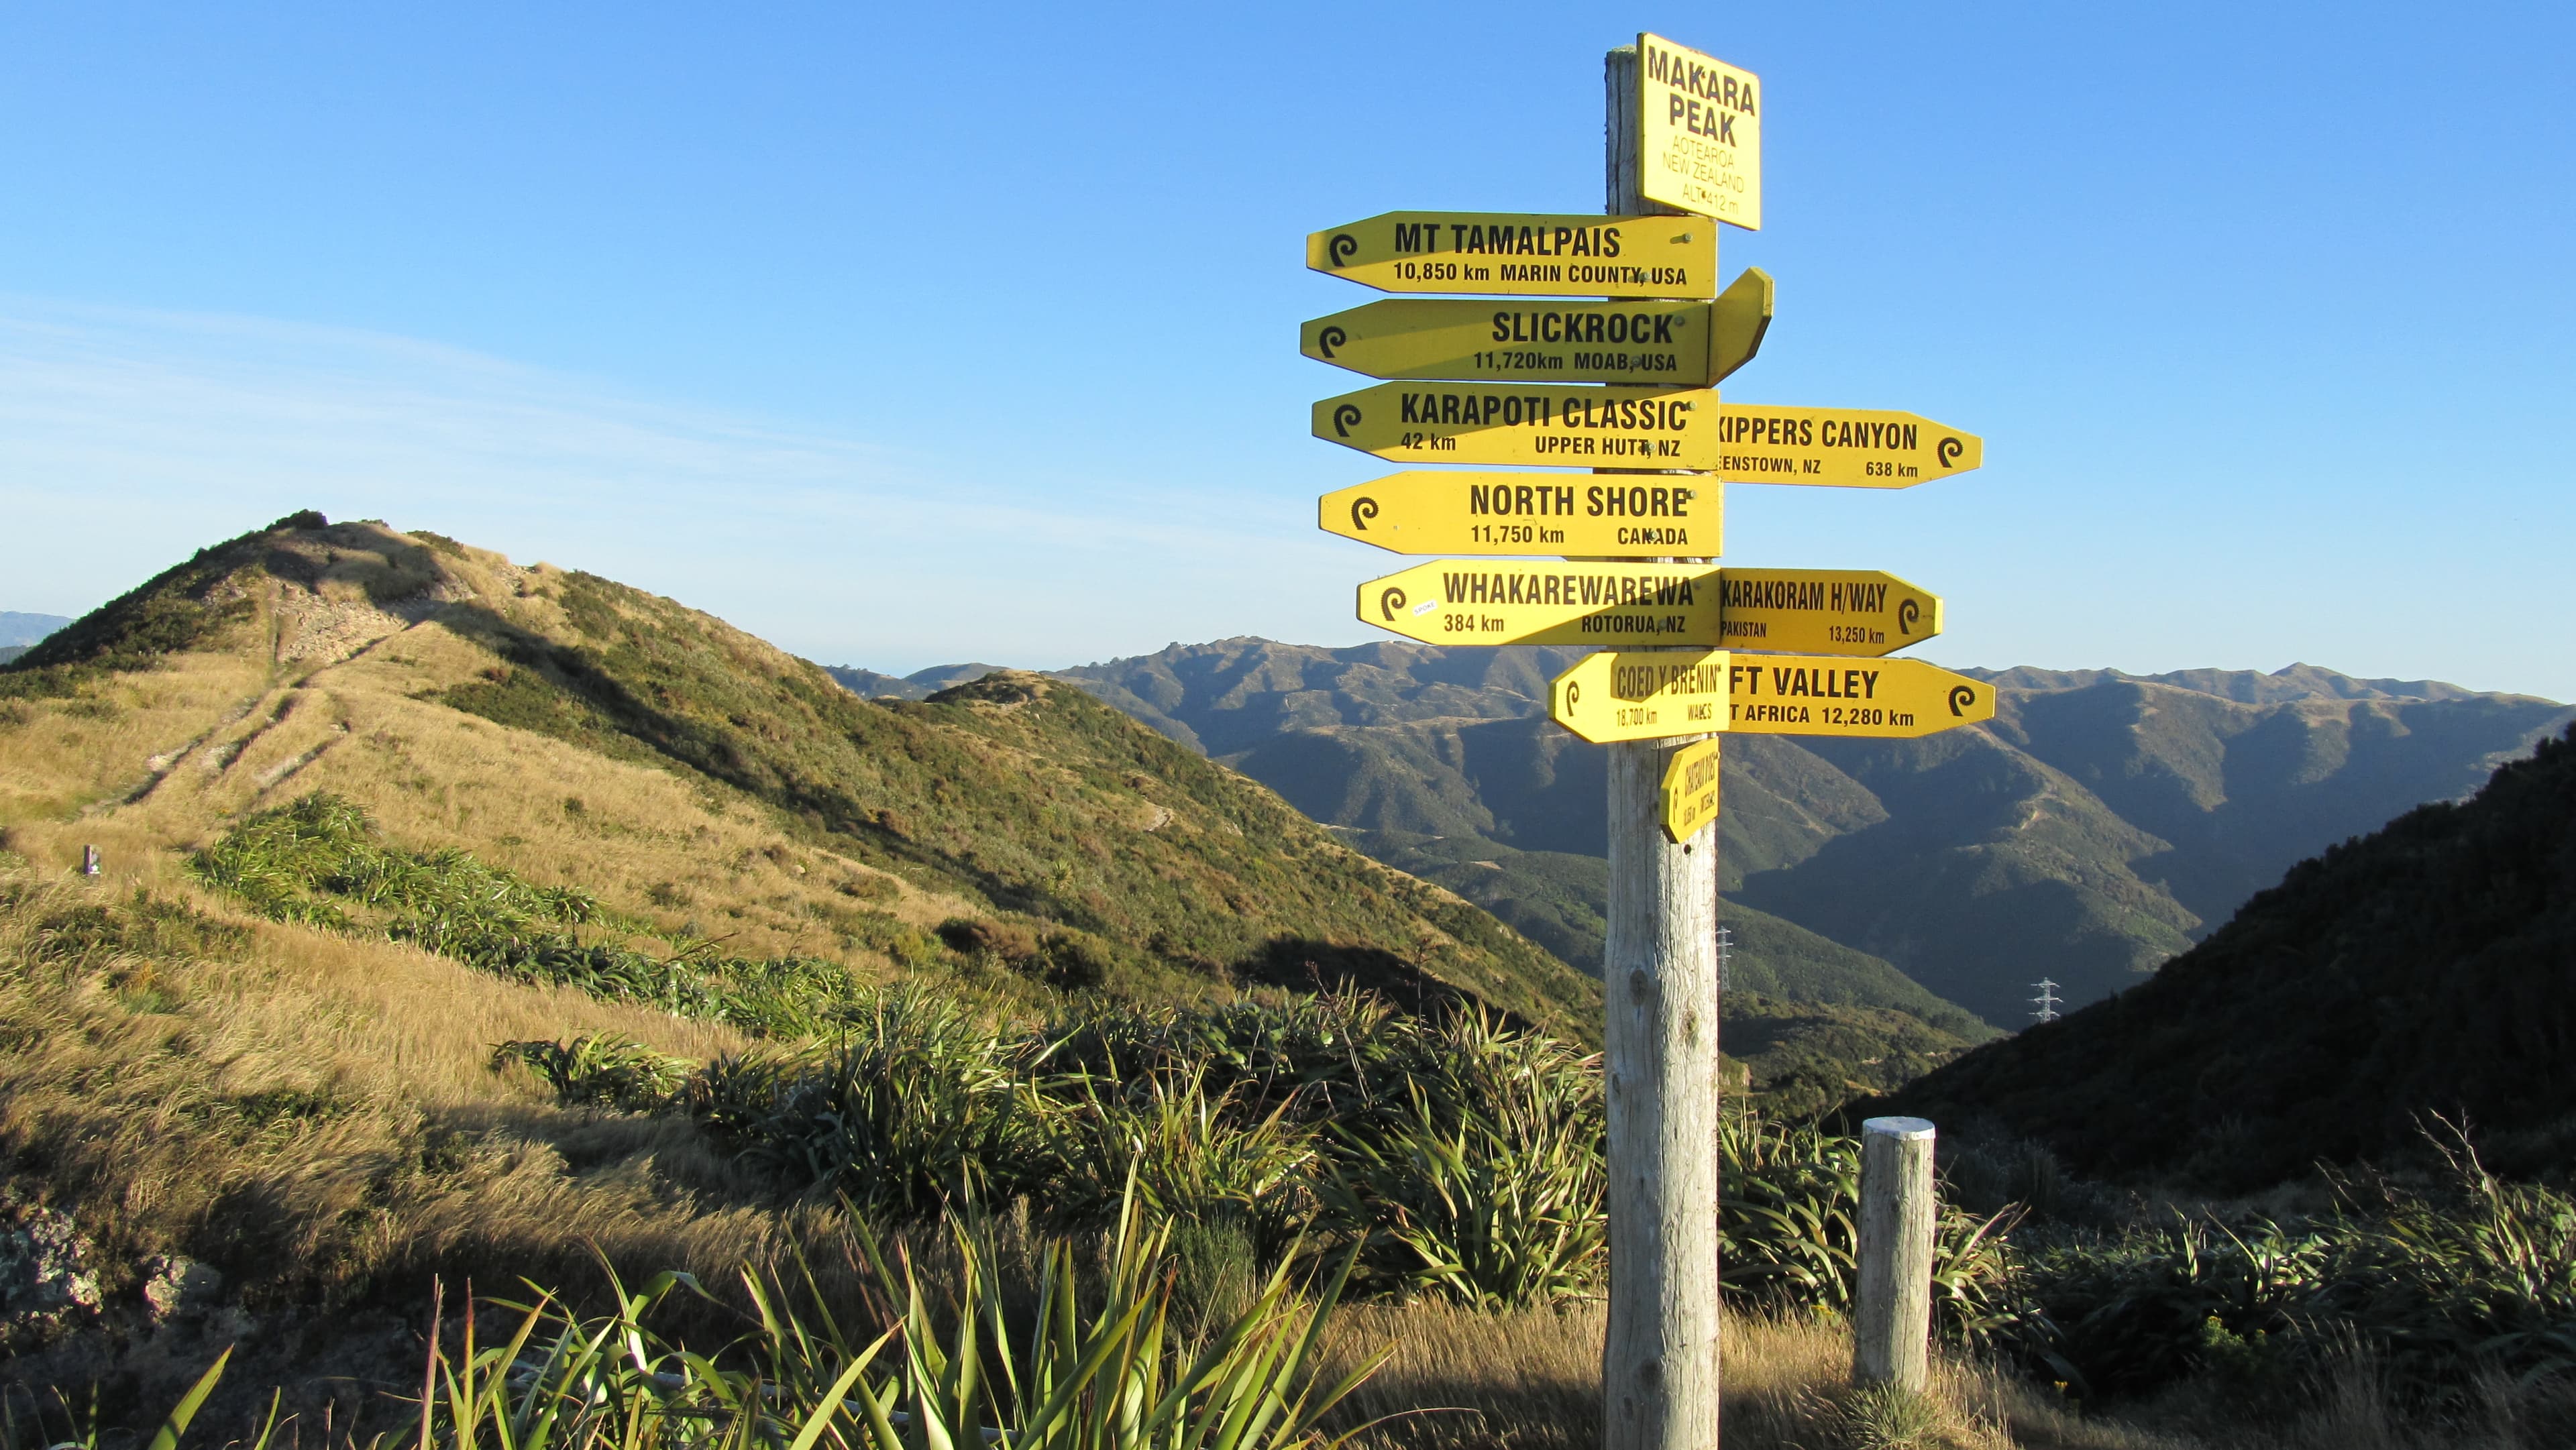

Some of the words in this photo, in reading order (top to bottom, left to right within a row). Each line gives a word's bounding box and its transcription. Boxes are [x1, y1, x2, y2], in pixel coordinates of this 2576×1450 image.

[1648, 45, 1756, 117] MAKARA
[1670, 93, 1737, 148] PEAK
[1672, 135, 1734, 169] AOTEAROA
[1663, 152, 1690, 176] NEW
[1693, 161, 1744, 193] ZEALAND
[1707, 192, 1725, 211] 412
[1729, 201, 1738, 215] m
[1395, 223, 1440, 252] MT
[1450, 224, 1621, 258] TAMALPAIS
[1394, 262, 1457, 283] 10,850
[1464, 263, 1489, 280] km
[1501, 264, 1562, 282] MARIN
[1568, 265, 1644, 287] COUNTY,
[1652, 267, 1687, 285] USA
[1493, 312, 1674, 344] SLICKROCK
[1474, 352, 1563, 372] 11,720km
[1574, 353, 1635, 374] MOAB,
[1642, 355, 1677, 372] USA
[1401, 393, 1550, 427] KARAPOTI
[1562, 398, 1687, 431] CLASSIC
[1401, 433, 1423, 450] 42
[1431, 433, 1456, 451] km
[1535, 435, 1595, 455] UPPER
[1602, 437, 1651, 459] HUTT,
[1659, 439, 1680, 457] NZ
[1821, 420, 1917, 450] CANYON
[1719, 455, 1798, 476] ENSTOWN,
[1803, 459, 1821, 474] NZ
[1866, 461, 1892, 477] 638
[1898, 462, 1919, 478] km
[1470, 485, 1574, 516] NORTH
[1587, 486, 1688, 517] SHORE
[1471, 525, 1532, 546] 11,750
[1540, 526, 1564, 543] km
[1617, 526, 1688, 545] CANADA
[1444, 572, 1693, 606] WHAKAREWAREWA
[1721, 579, 1824, 611] KARAKORAM
[1831, 582, 1887, 615] H/WAY
[1444, 614, 1474, 632] 384
[1481, 614, 1505, 632] km
[1582, 615, 1660, 635] ROTORUA,
[1666, 616, 1686, 632] NZ
[1721, 621, 1766, 638] PAKISTAN
[1829, 626, 1865, 645] 13,250
[1870, 628, 1884, 645] km
[1617, 665, 1654, 698] COED
[1658, 665, 1667, 695] Y
[1671, 663, 1718, 695] BRENIN
[1729, 666, 1763, 694] FT
[1772, 667, 1879, 699] VALLEY
[1617, 708, 1644, 729] 18,700
[1646, 708, 1657, 724] km
[1687, 703, 1711, 722] WALES
[1745, 705, 1810, 723] AFRICA
[1822, 708, 1882, 728] 12,280
[1889, 710, 1914, 726] km
